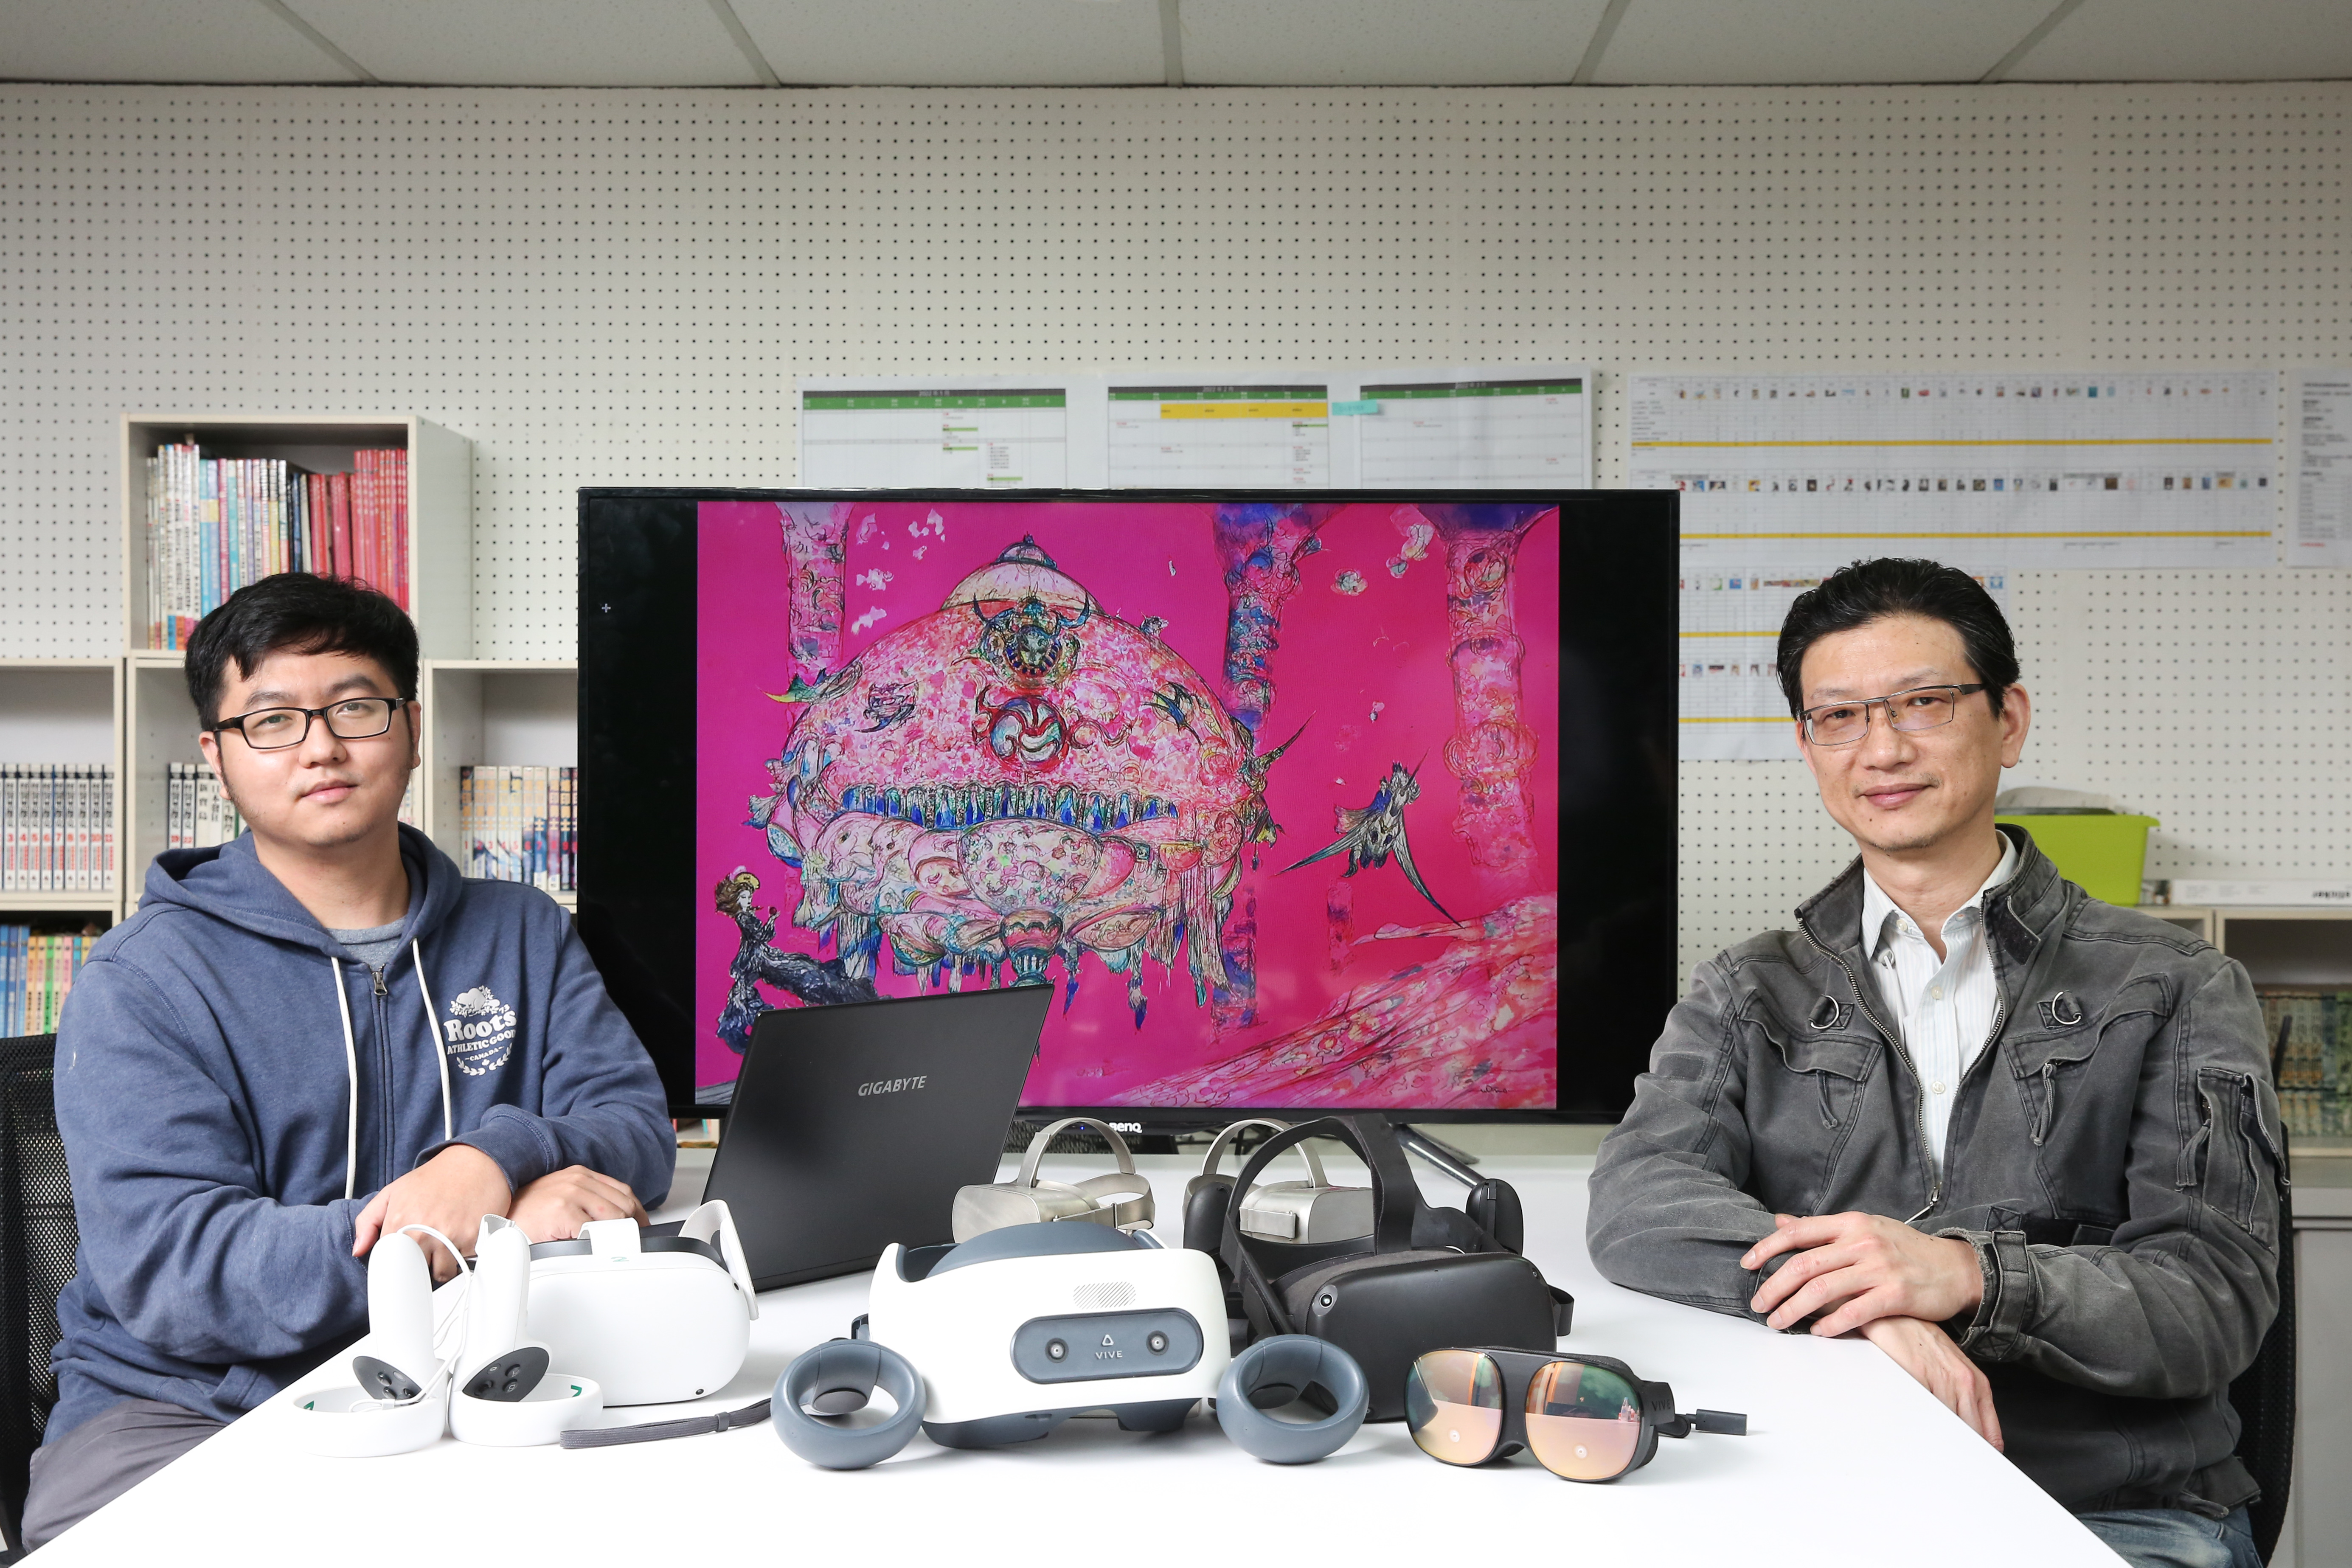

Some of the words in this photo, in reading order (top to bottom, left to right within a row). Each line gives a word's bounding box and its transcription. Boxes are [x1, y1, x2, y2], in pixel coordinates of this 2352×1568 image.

[499, 1004, 510, 1014] 73
[443, 1010, 517, 1042] Roots
[447, 1040, 490, 1055] ATHLETIC
[469, 1048, 499, 1062] CANADA
[858, 1075, 927, 1096] GIGABYTE
[1095, 1350, 1123, 1360] VIVE
[1651, 1399, 1671, 1411] VIVE
